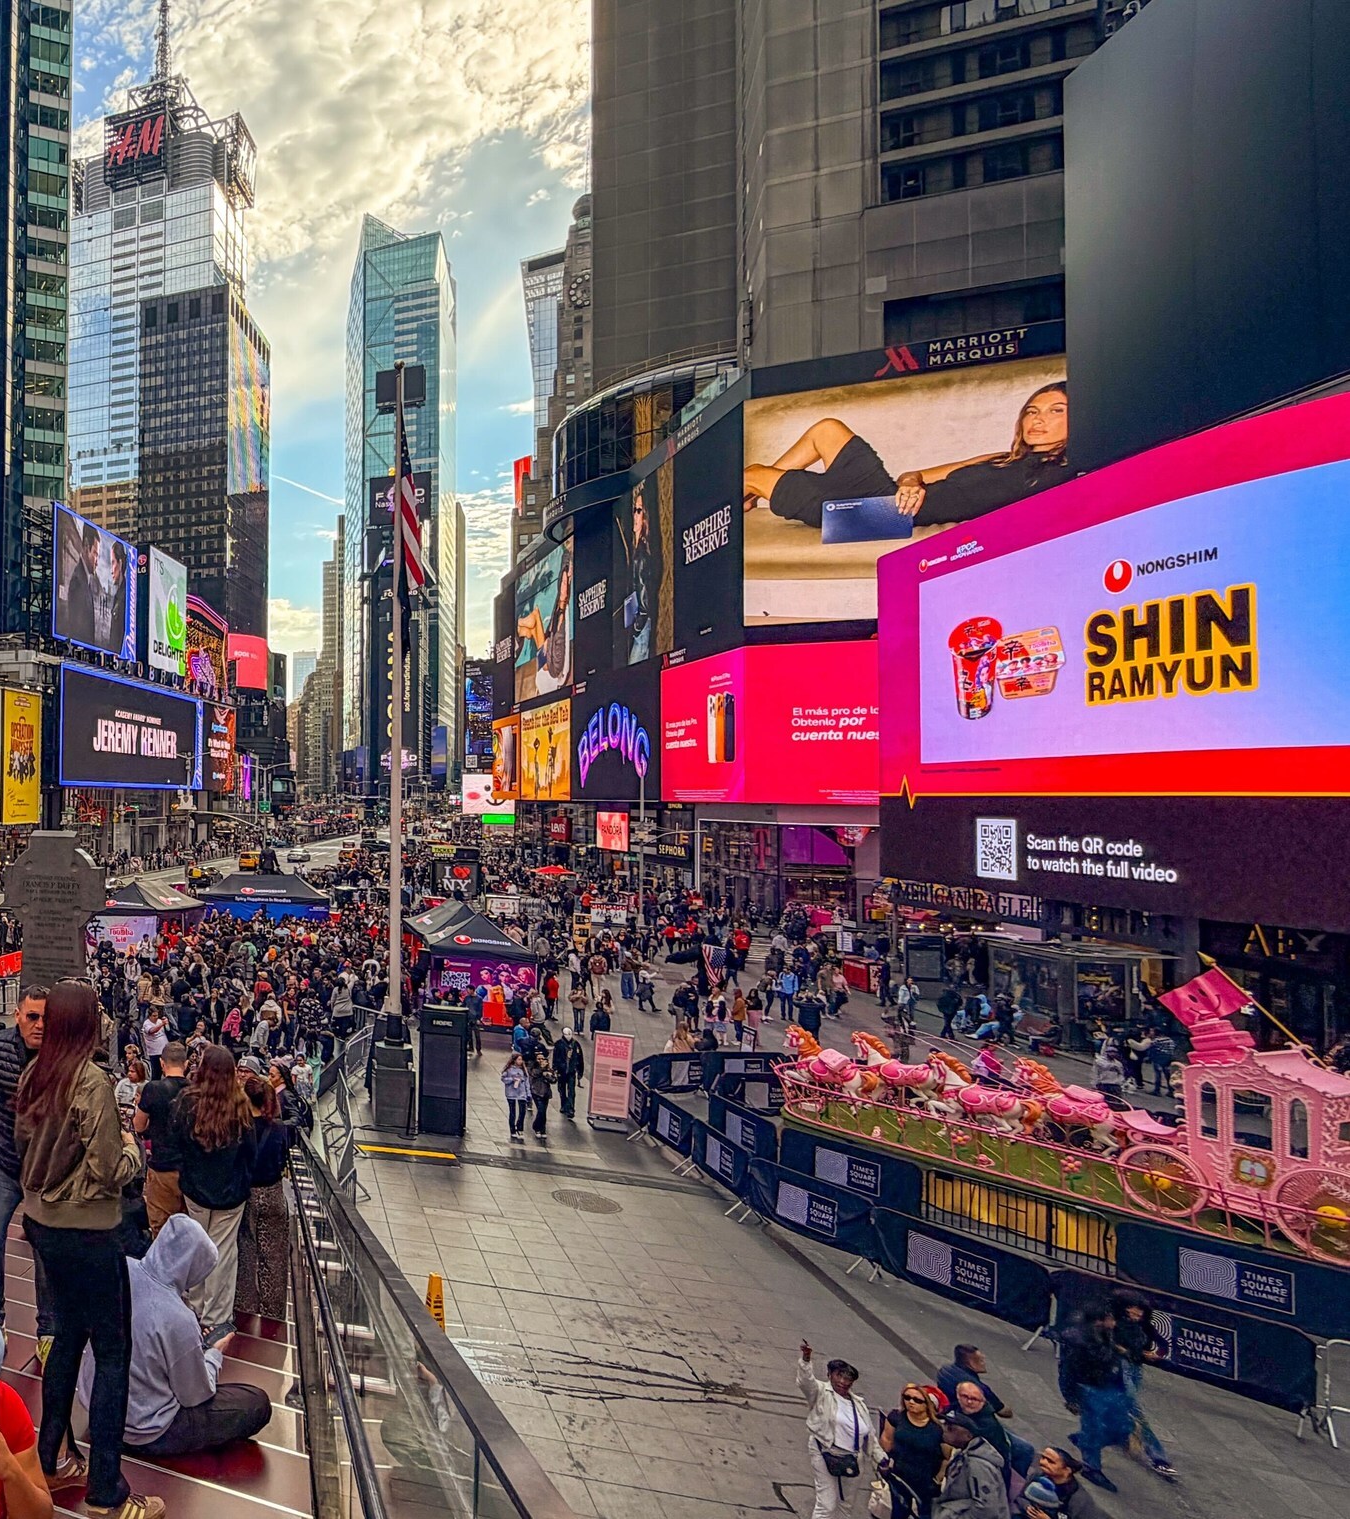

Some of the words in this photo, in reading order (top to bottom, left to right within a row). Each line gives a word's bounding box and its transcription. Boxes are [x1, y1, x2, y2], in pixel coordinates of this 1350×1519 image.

[107, 114, 165, 168] H&M
[929, 328, 1028, 353] MARRIOTT
[929, 343, 1016, 366] MARQUIS
[682, 505, 731, 548] SAPPHIRE
[684, 527, 729, 565] RESERVE
[138, 566, 147, 574] LG
[1136, 547, 1218, 577] NONGSHIM
[578, 578, 607, 606] SAPPHIRE
[579, 595, 607, 620] RESERVE
[1086, 587, 1251, 668] SHIN
[1087, 651, 1252, 702] RAMYUN
[792, 707, 803, 716] El
[805, 706, 829, 716] más
[831, 707, 850, 718] pro
[852, 706, 867, 715] de
[791, 718, 836, 727] Obtenlo
[839, 716, 866, 729] por
[93, 719, 138, 755] JEREMY
[140, 727, 177, 760] RENNER
[578, 702, 650, 788] BELONG
[792, 730, 844, 741] cuenta
[601, 823, 623, 837] PANDORA
[658, 843, 686, 858] SEPHORA
[1026, 833, 1055, 854] Scan
[1058, 836, 1079, 855] the
[1081, 837, 1103, 857] QR
[1106, 838, 1143, 858] code
[1026, 856, 1040, 871] to
[1041, 857, 1079, 876] watch
[1081, 859, 1104, 878] the
[1106, 860, 1129, 880] full
[1131, 862, 1177, 884] video
[57, 882, 81, 890] DUFFY
[442, 878, 472, 892] NY
[891, 881, 970, 911] AMERICAN
[973, 887, 1031, 920] EAGLE
[108, 927, 134, 937] Toomba
[472, 937, 512, 947] NONGSHIM
[850, 1169, 877, 1184] SQUARE
[851, 1163, 875, 1176] TIMES
[851, 1177, 875, 1189] ALLIANCE
[809, 1207, 834, 1223] SQUARE
[812, 1200, 832, 1214] TIMES
[810, 1216, 833, 1229] ALLIANCE
[954, 1265, 992, 1285] SQUARE
[957, 1257, 989, 1275] TIMES
[956, 1275, 990, 1293] ALLIANCE
[1240, 1278, 1288, 1297] SQUARE
[1244, 1270, 1283, 1287] TIMES
[1243, 1288, 1286, 1304] ALLIANCE
[1181, 1327, 1225, 1347] TIMES
[1177, 1337, 1230, 1359] SQUARE
[1180, 1349, 1227, 1368] ALLIANCE
